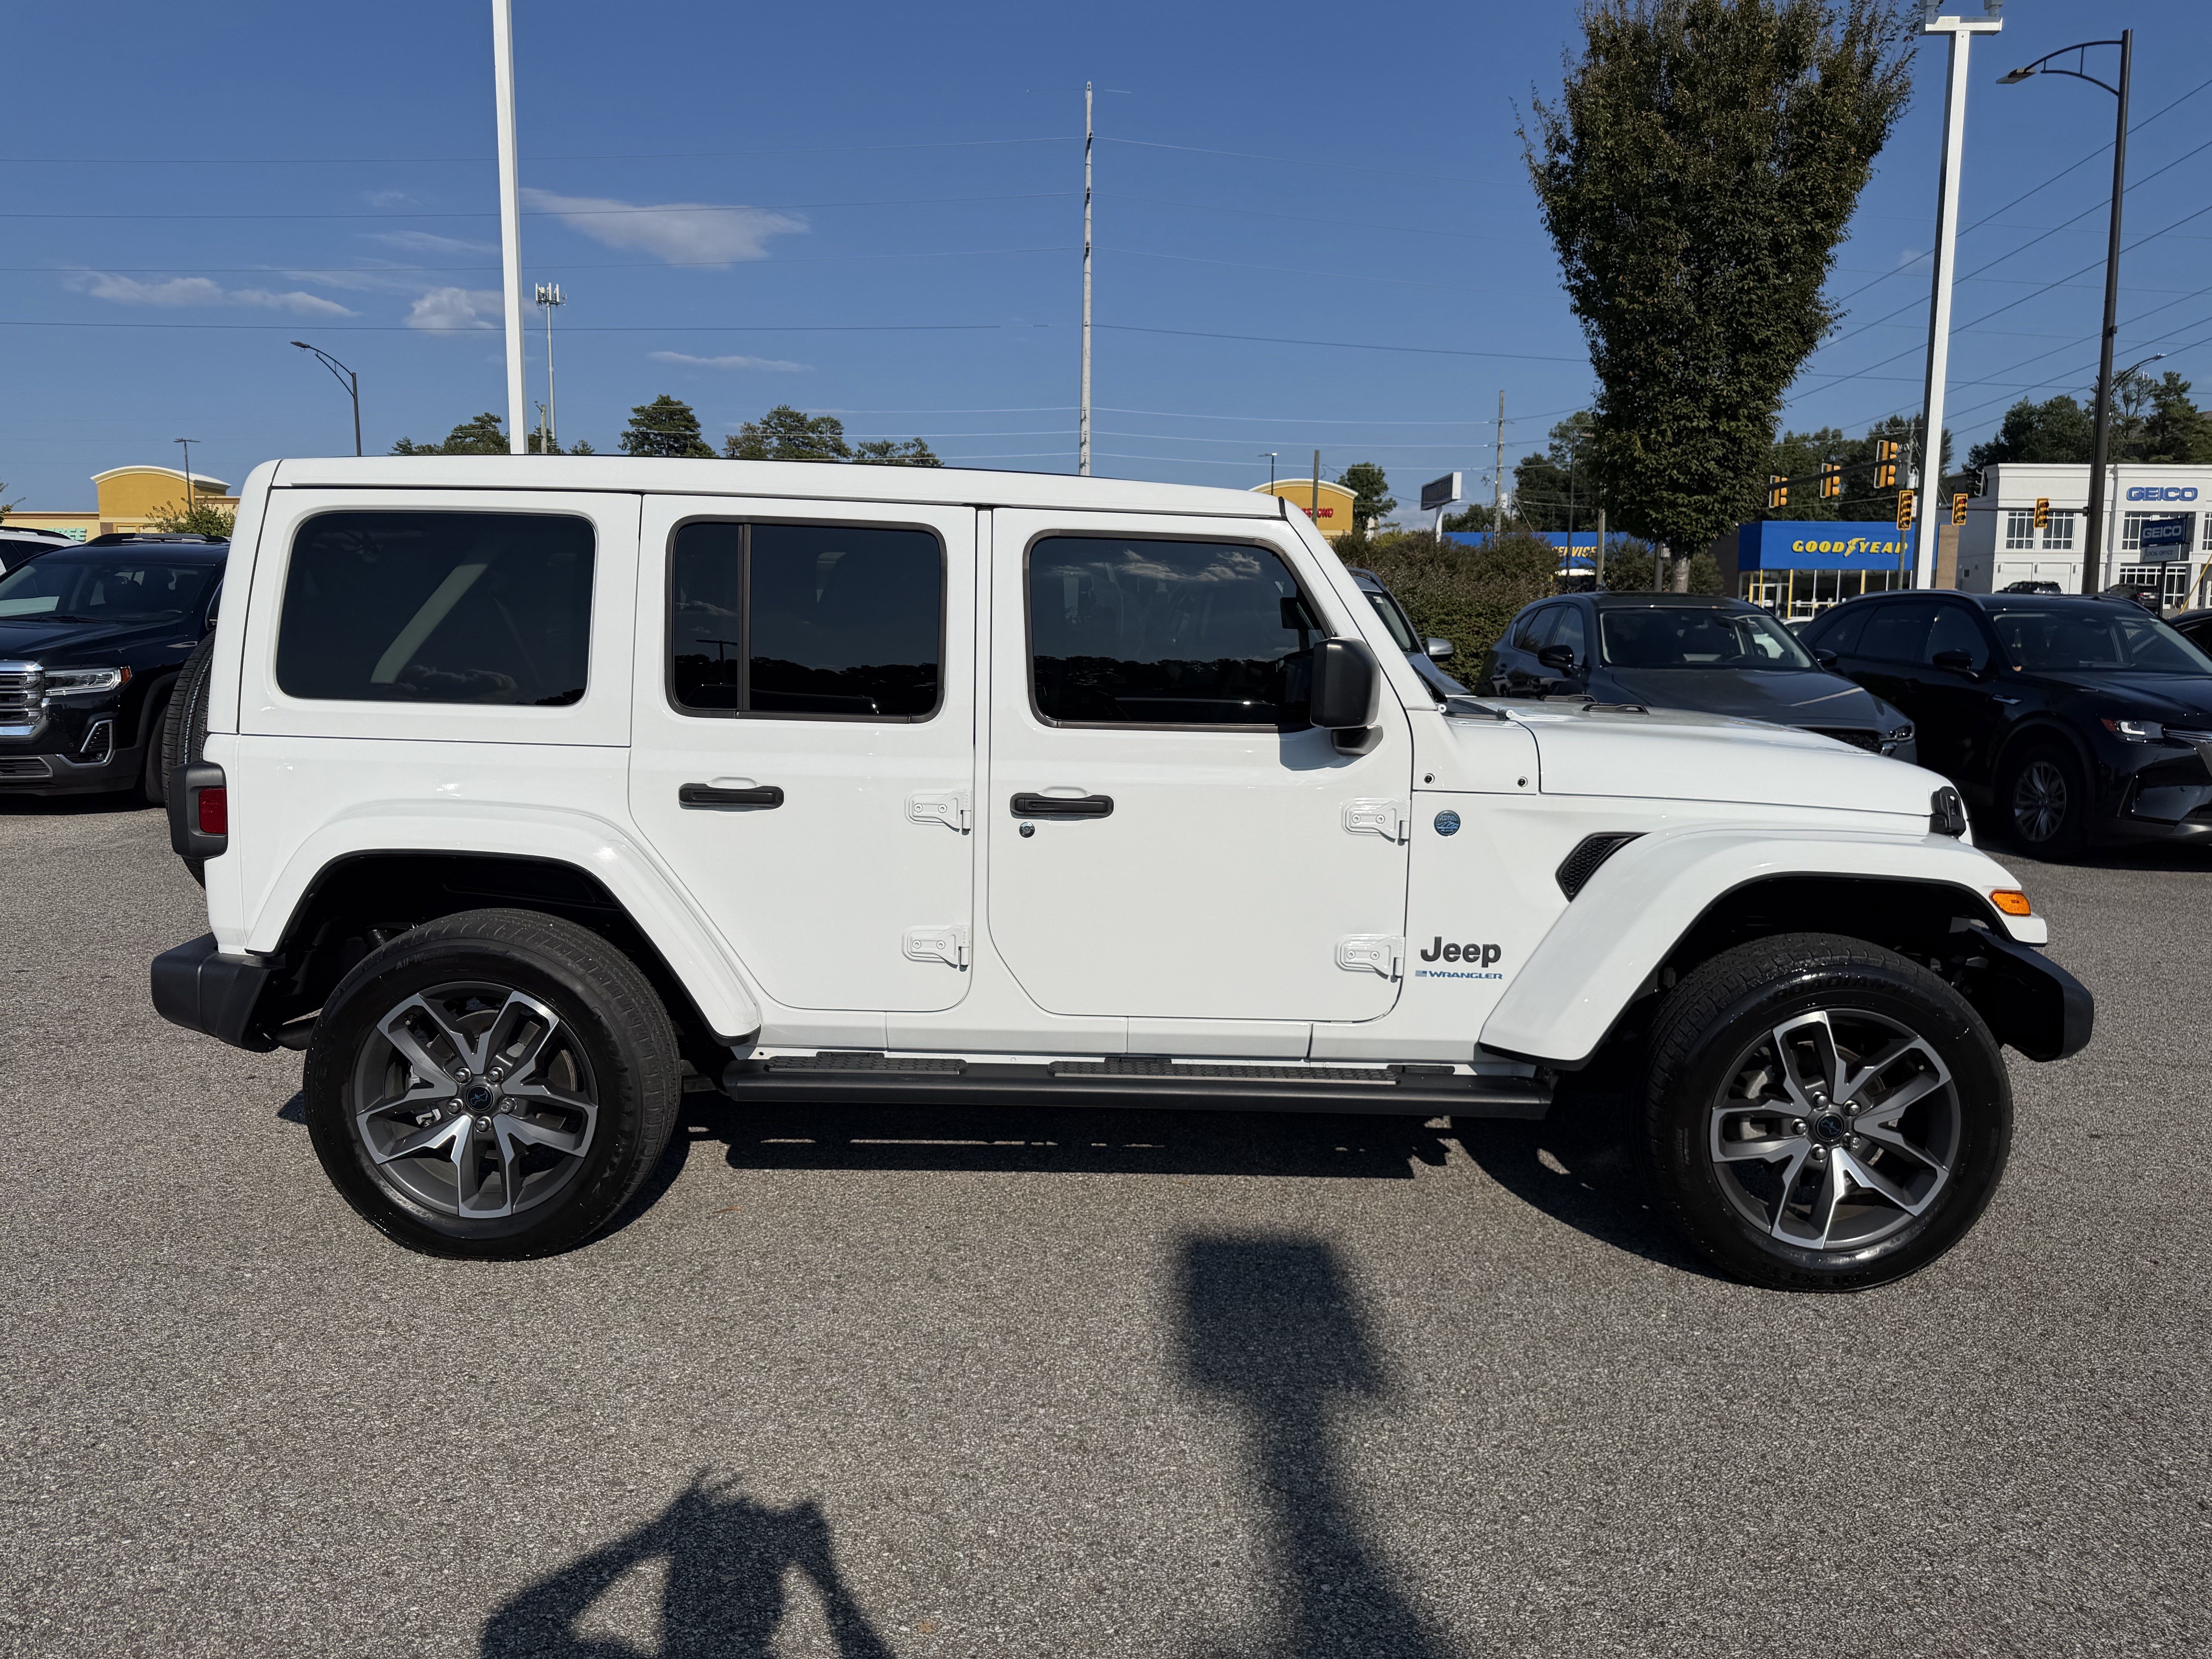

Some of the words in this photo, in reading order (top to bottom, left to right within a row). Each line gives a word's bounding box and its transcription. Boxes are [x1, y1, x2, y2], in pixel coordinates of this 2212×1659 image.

[2126, 487, 2198, 501] GEICO
[1302, 508, 1333, 518] EOND
[43, 528, 86, 541] EE
[2143, 525, 2182, 539] GEICO
[1420, 936, 1501, 968] Jeep
[1429, 970, 1503, 979] WRANGLER
